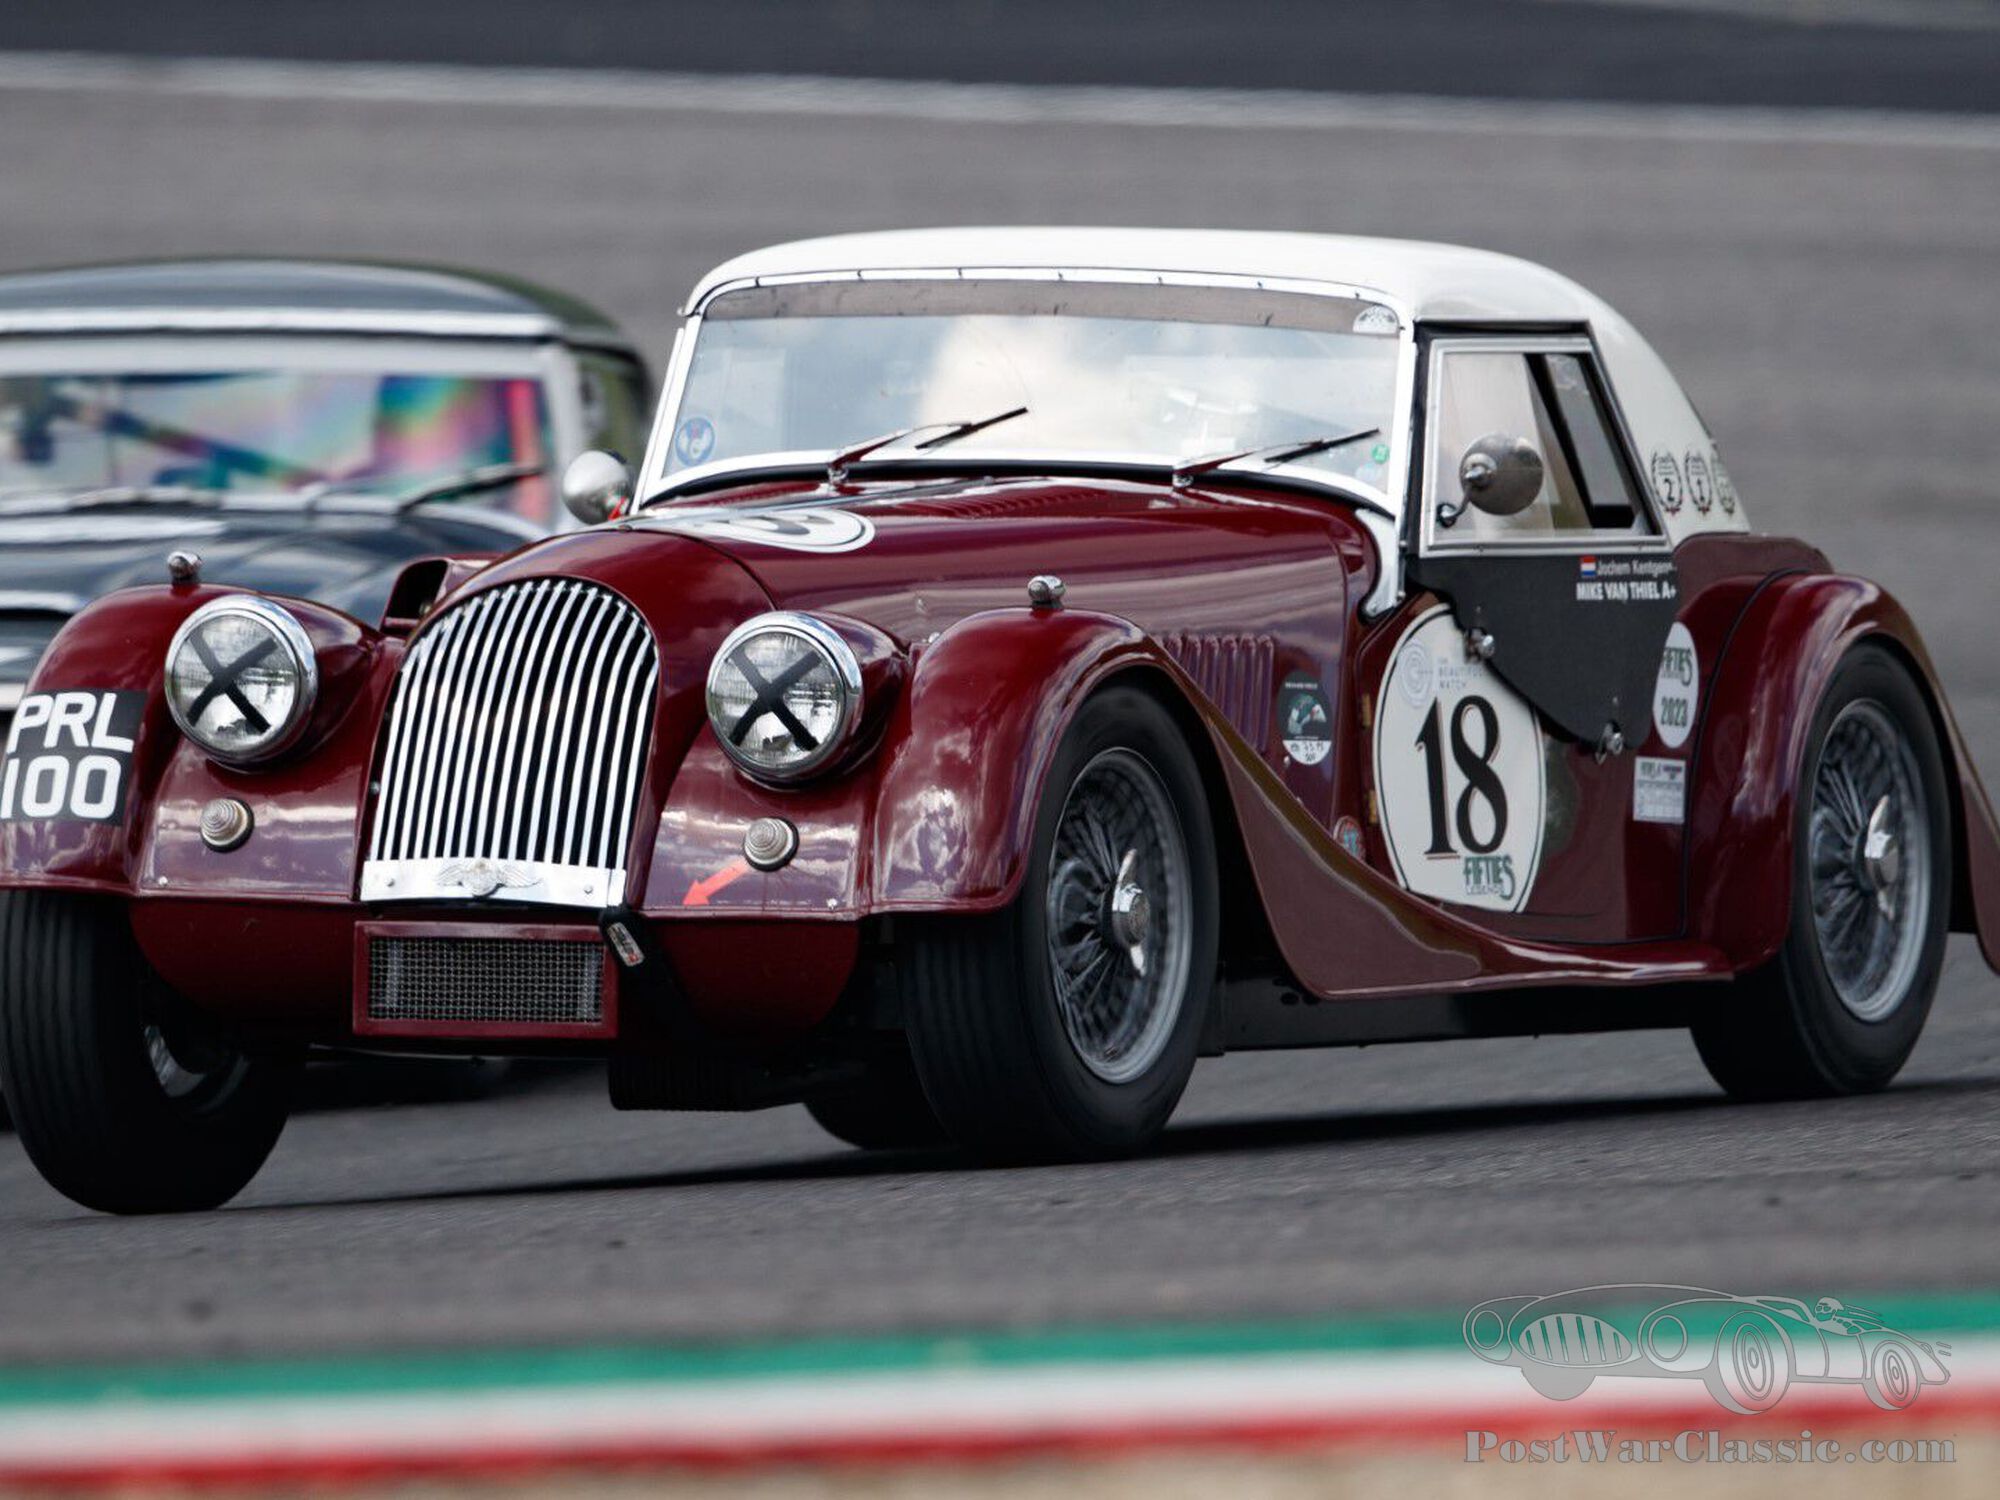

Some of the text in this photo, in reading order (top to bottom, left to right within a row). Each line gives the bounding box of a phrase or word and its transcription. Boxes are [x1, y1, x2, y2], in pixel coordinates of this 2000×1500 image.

[1576, 582, 1603, 600] MIKE
[1604, 582, 1629, 600] VAN
[1629, 581, 1661, 600] THIEL
[6, 692, 134, 754] PRL
[0, 755, 121, 819] 100
[1415, 695, 1508, 859] 18
